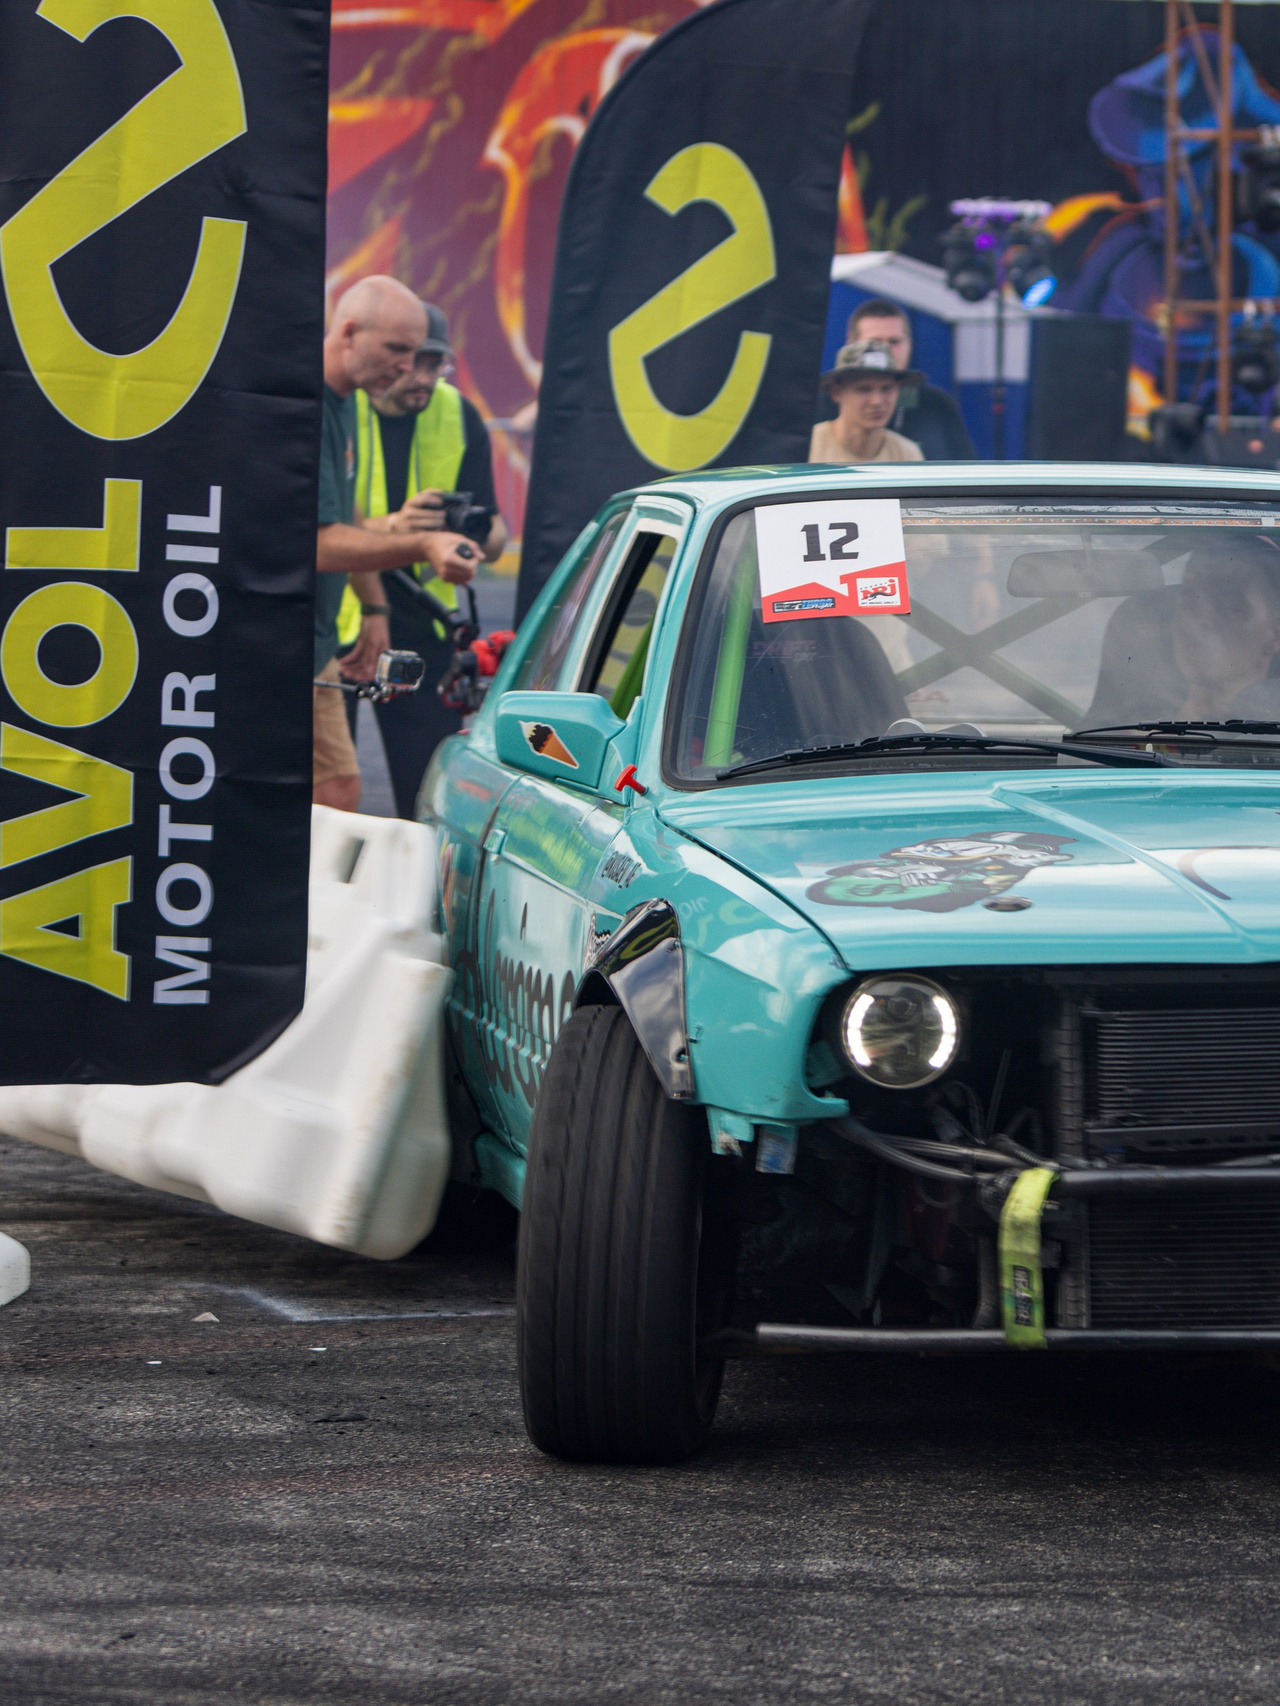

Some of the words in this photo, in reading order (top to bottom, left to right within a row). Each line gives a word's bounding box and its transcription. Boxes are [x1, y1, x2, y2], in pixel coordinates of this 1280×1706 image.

[162, 485, 222, 638] OIL
[800, 522, 859, 562] 12
[0, 477, 142, 1002] AVOL
[153, 671, 217, 1004] MOTOR
